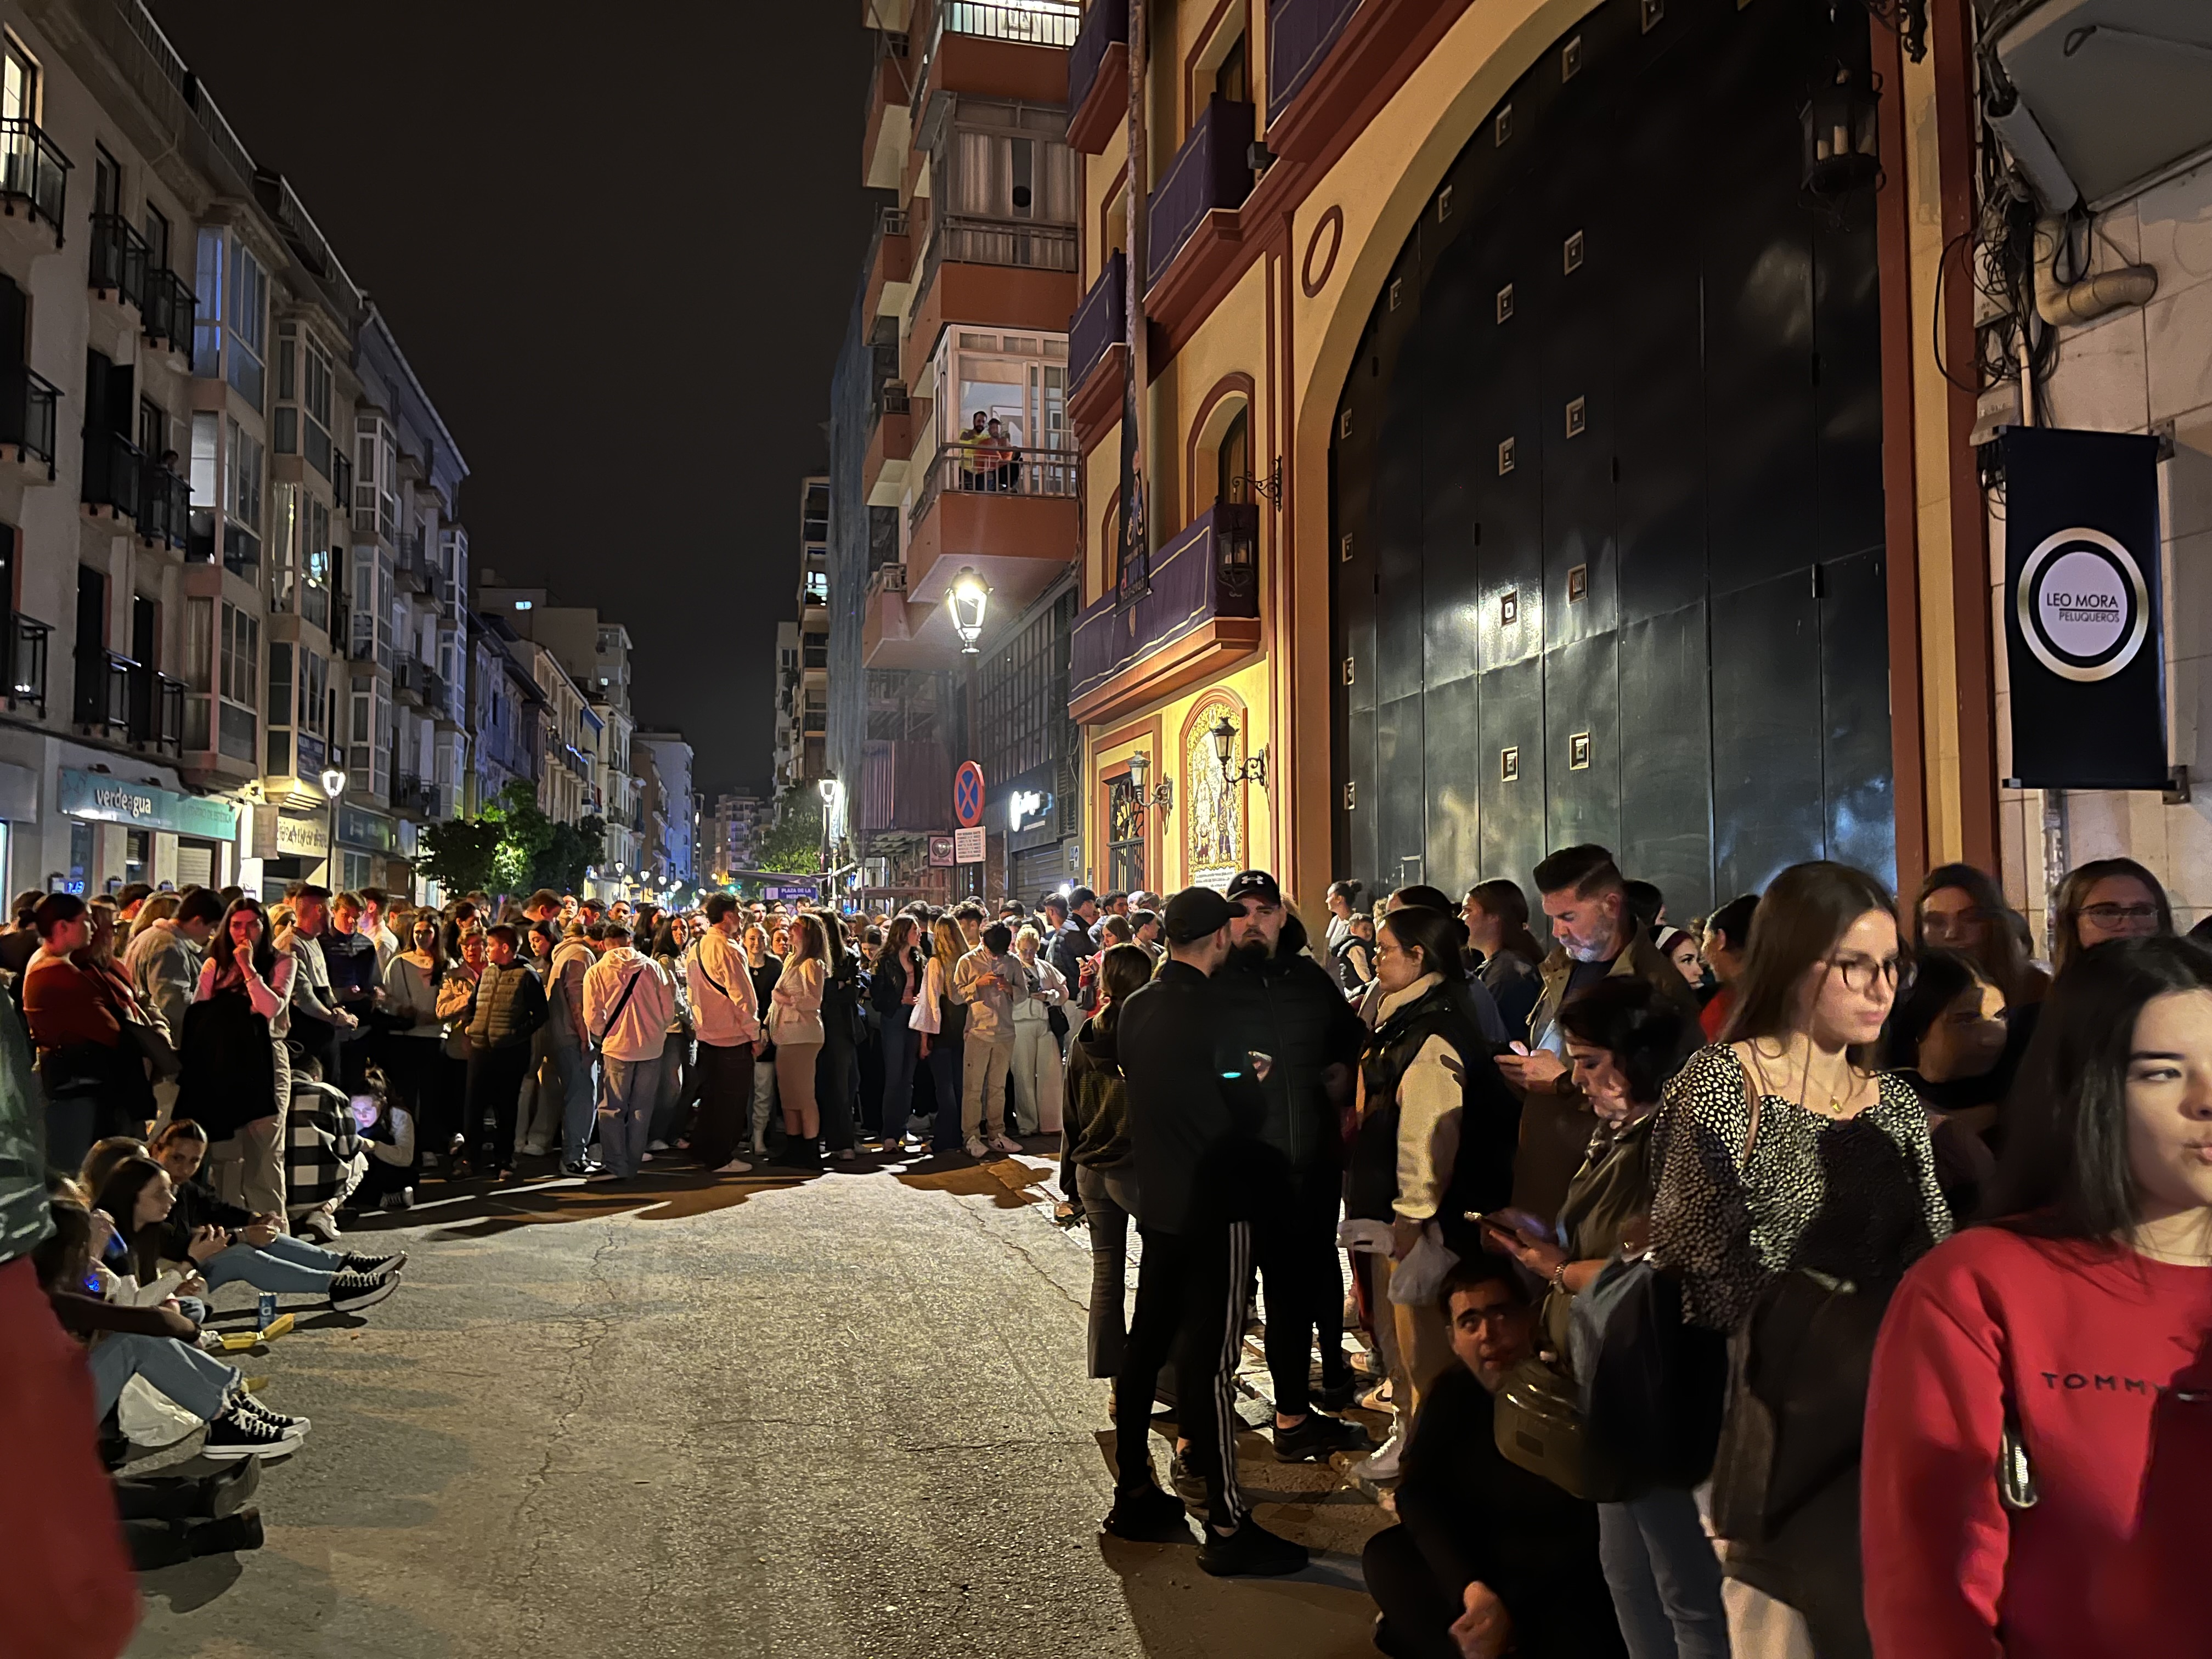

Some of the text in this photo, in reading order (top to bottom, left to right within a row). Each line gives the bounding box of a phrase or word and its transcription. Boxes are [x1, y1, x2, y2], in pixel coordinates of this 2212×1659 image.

[2046, 593, 2118, 608] LEO MORA
[2059, 612, 2120, 623] PELUQUEROS
[96, 787, 151, 818] verdeagua
